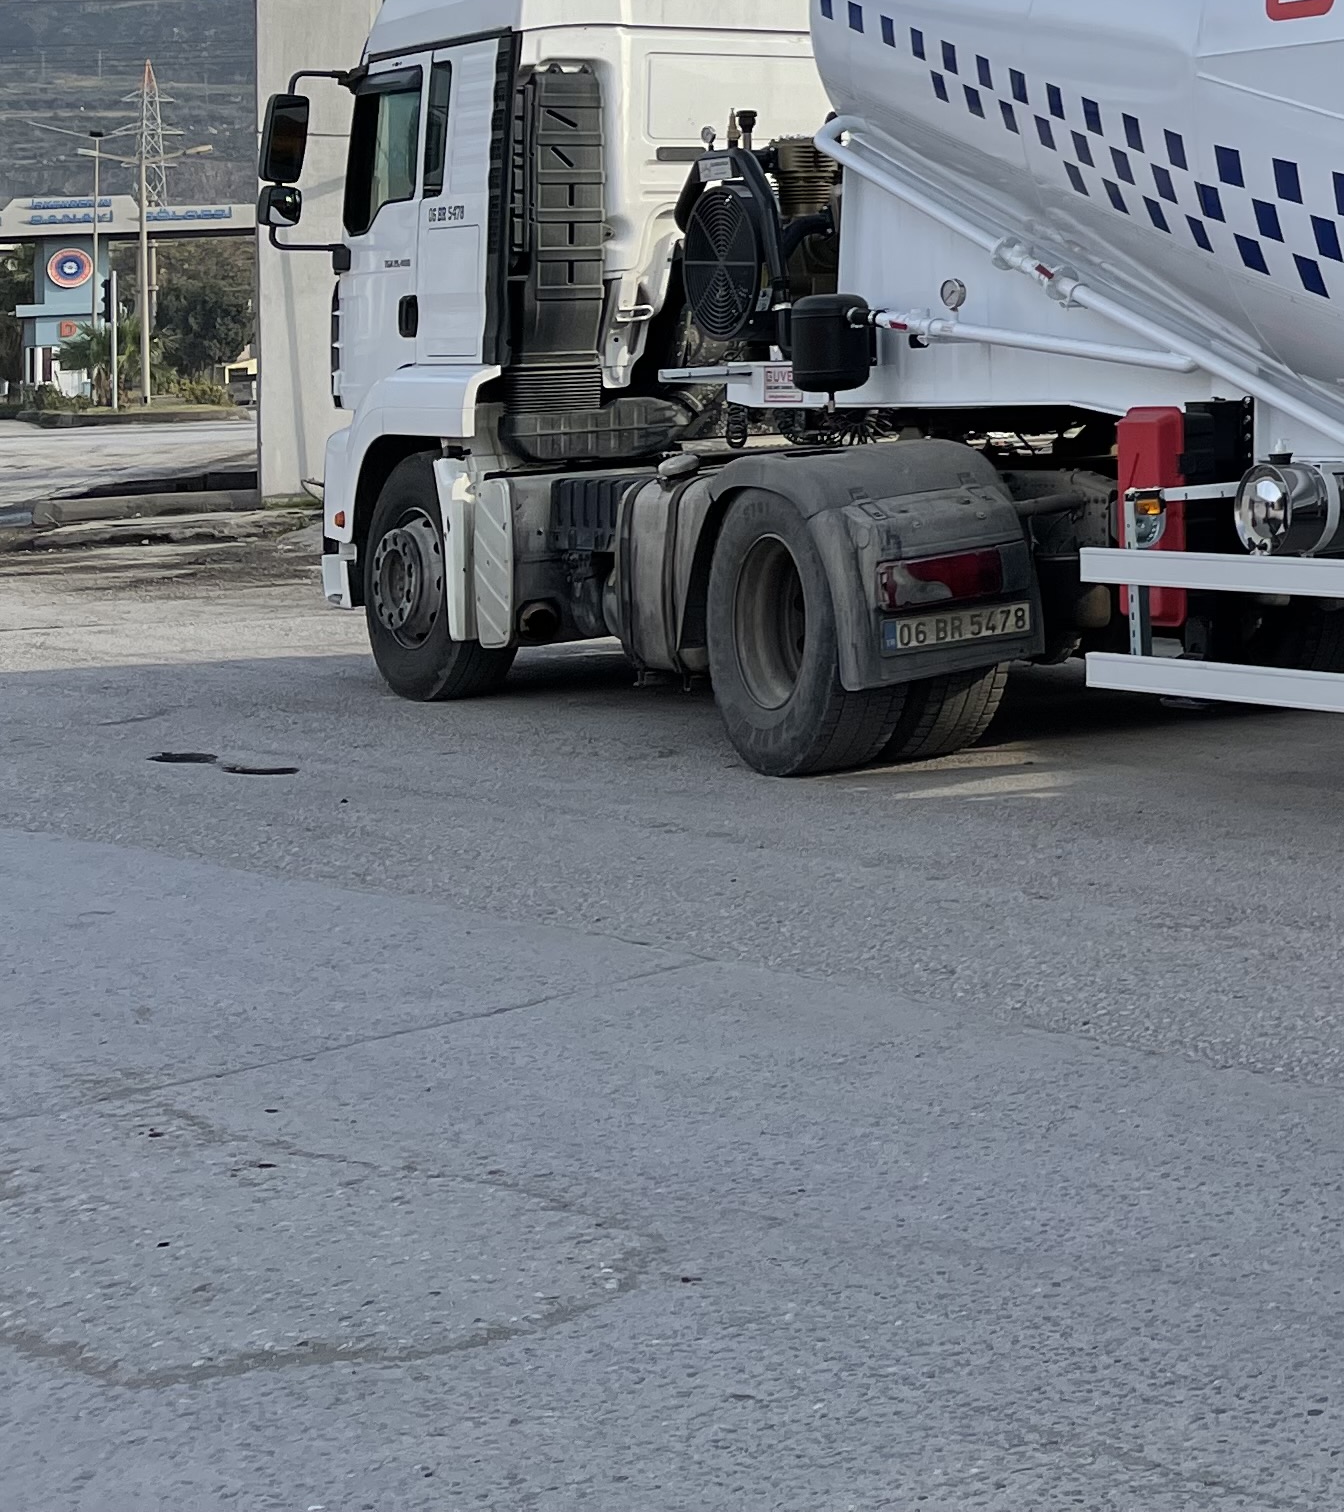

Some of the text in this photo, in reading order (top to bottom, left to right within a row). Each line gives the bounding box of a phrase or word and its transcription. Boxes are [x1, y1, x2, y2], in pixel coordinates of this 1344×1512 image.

[900, 607, 1026, 646] 06 BR 5478
